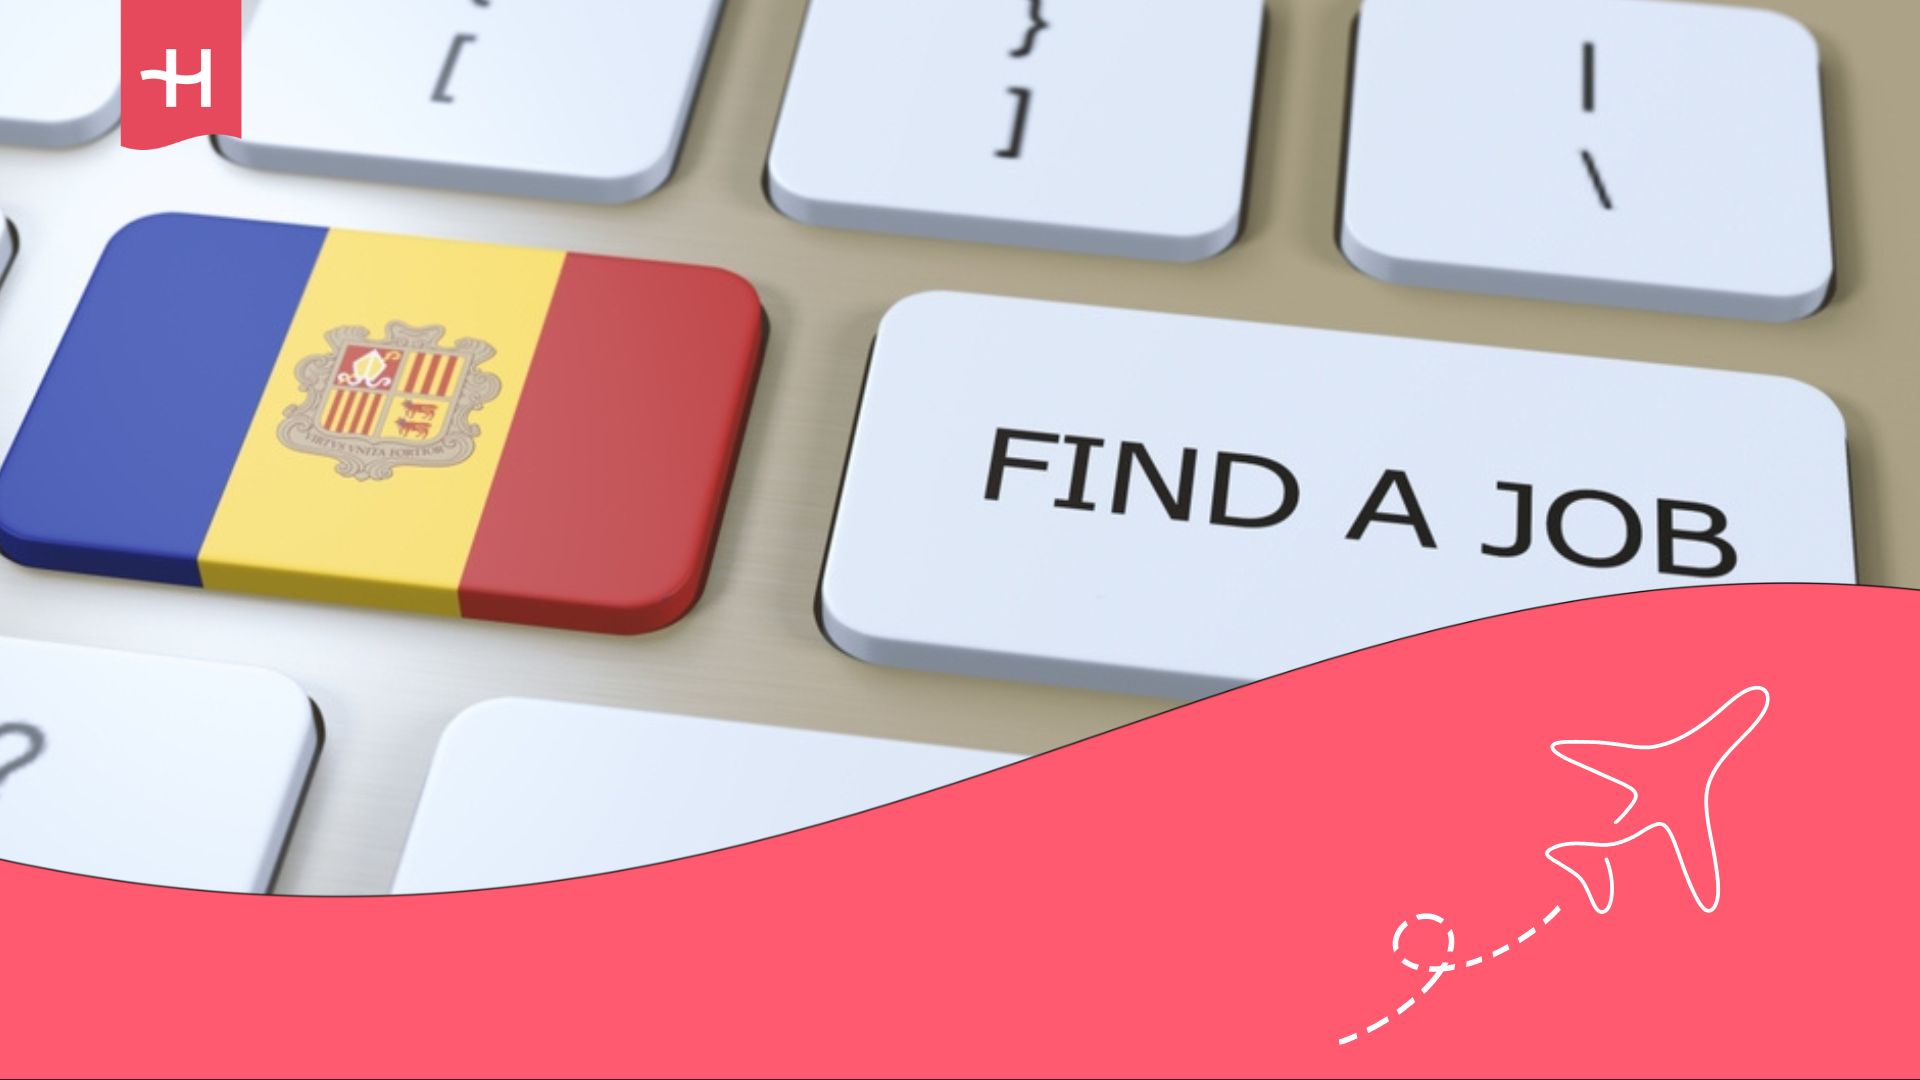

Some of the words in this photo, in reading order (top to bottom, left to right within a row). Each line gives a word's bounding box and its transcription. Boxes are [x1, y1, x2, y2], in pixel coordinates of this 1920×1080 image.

[430, 33, 477, 104] [
[994, 86, 1033, 159] ]
[984, 428, 1300, 528] FIND
[1345, 469, 1437, 549] A
[1480, 481, 1738, 578] JOB
